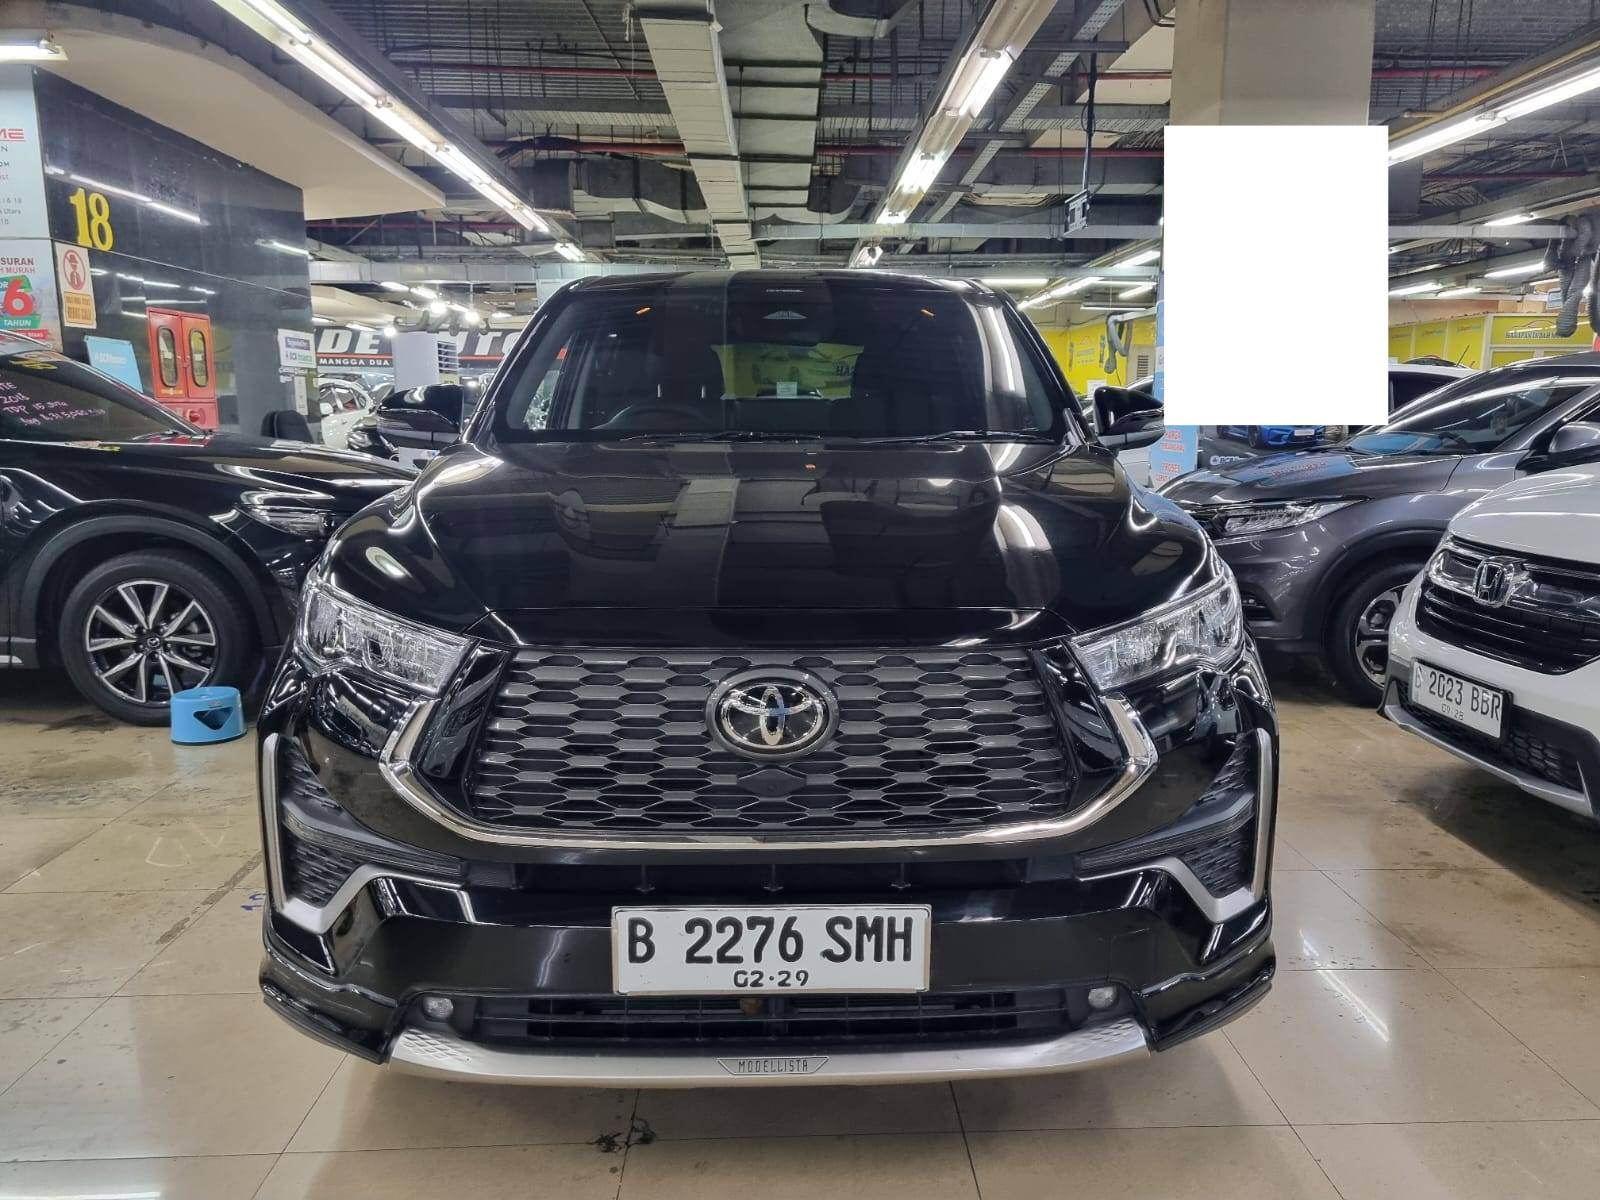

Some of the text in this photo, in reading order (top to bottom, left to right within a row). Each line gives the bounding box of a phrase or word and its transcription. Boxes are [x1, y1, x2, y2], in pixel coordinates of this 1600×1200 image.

[69, 188, 114, 251] 18
[5, 278, 33, 316] 6
[1428, 671, 1463, 706] 2023
[1471, 686, 1501, 721] BBR
[628, 916, 913, 964] B 2276 SMH
[738, 1060, 808, 1073] MODELLISTA
